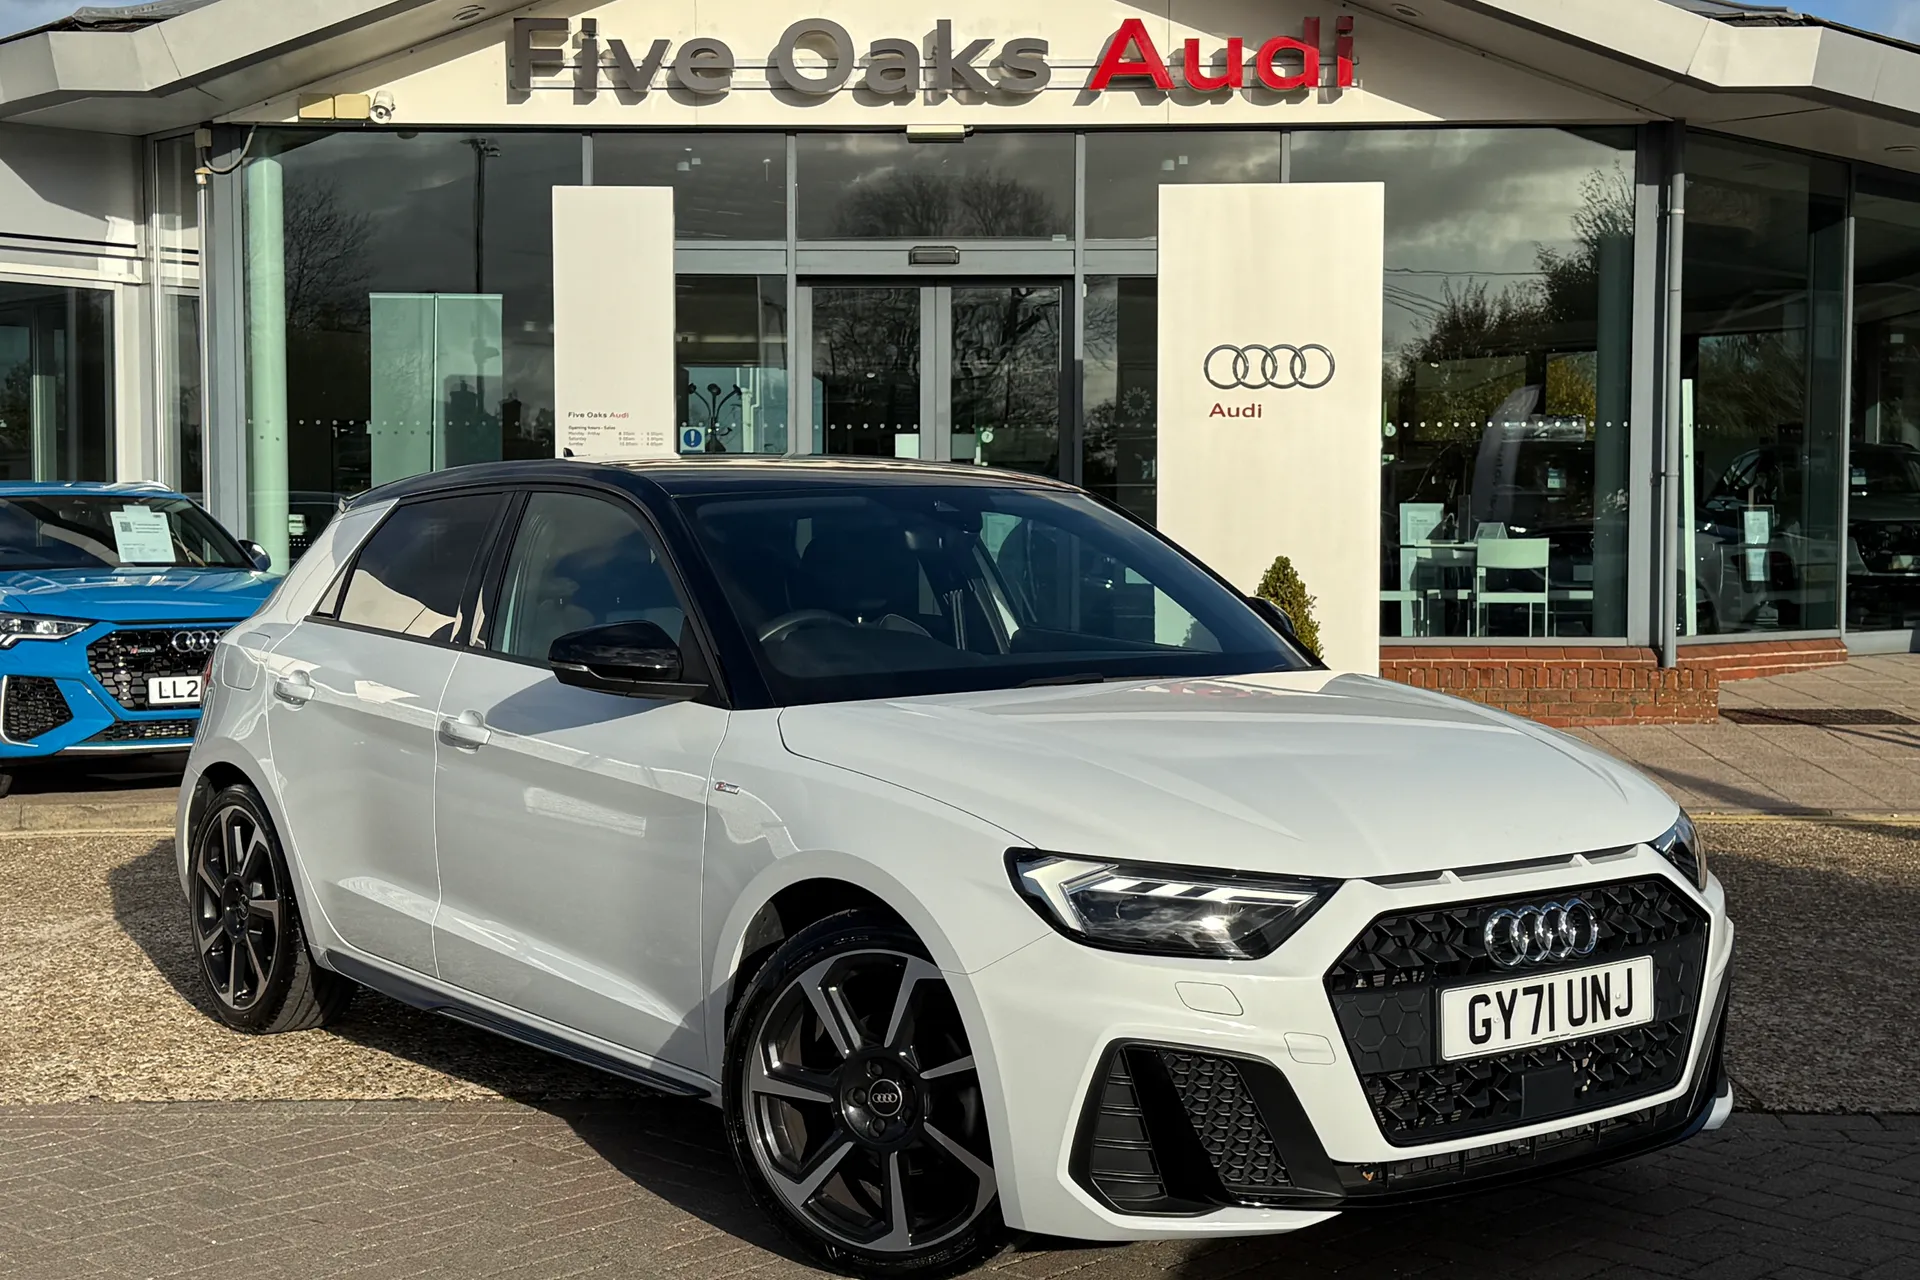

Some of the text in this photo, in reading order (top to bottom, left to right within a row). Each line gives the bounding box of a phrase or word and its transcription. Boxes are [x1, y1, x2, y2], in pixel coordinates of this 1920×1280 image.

[513, 16, 1354, 95] Five Oaks Audi
[609, 411, 629, 419] Audi
[1209, 402, 1262, 418] Audi
[1468, 967, 1633, 1045] GY71 UNJ
